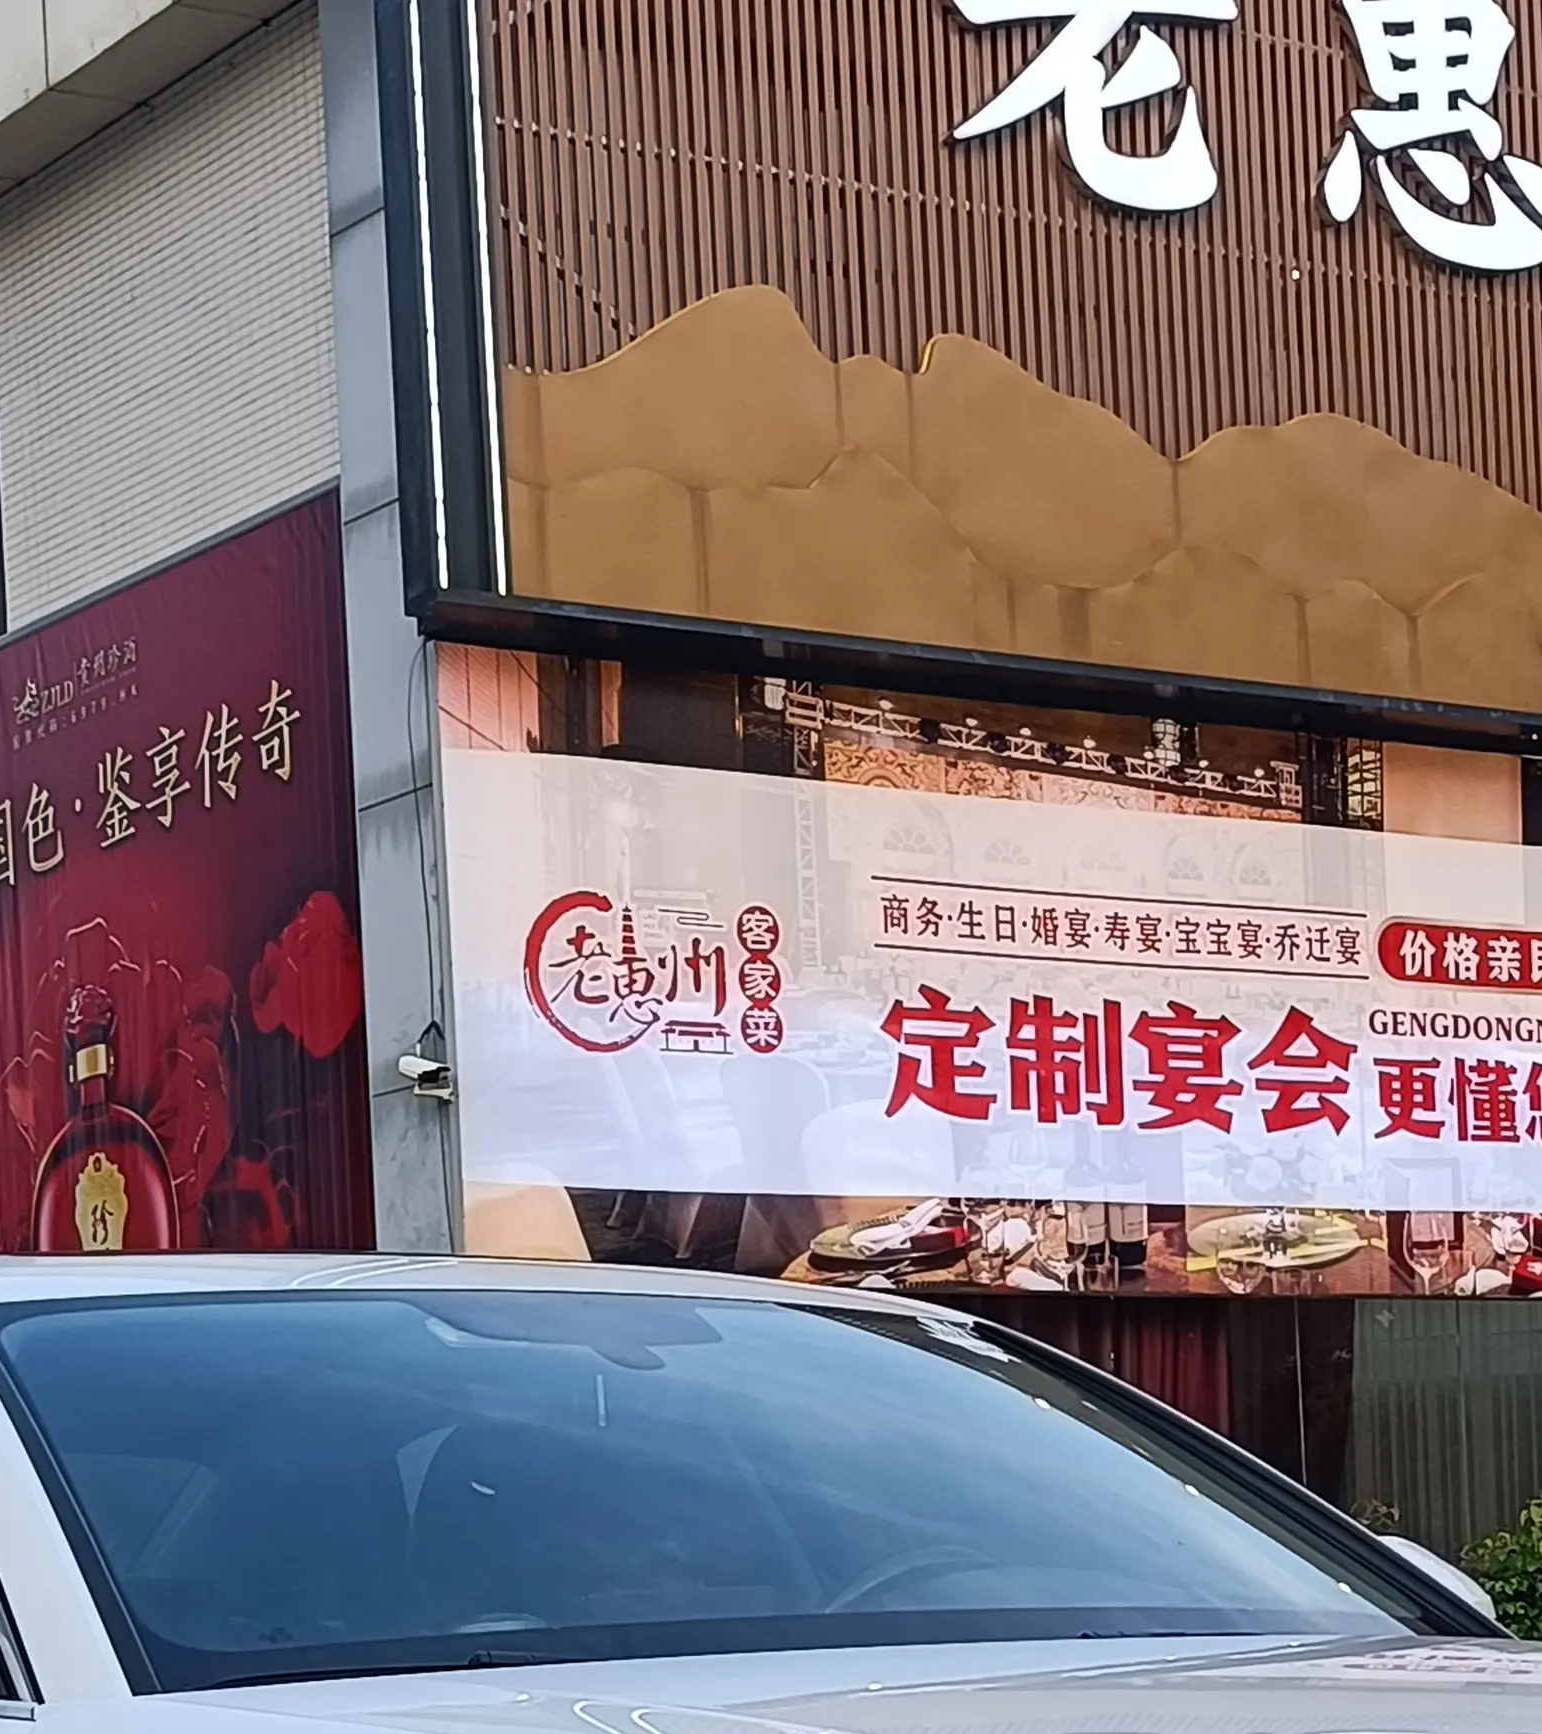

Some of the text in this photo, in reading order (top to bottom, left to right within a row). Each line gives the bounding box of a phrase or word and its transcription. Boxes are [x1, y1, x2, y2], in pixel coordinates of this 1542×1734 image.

[548, 905, 727, 1025] 老惠州
[741, 911, 779, 1047] 客家菜
[879, 983, 1359, 1135] 定制宴会
